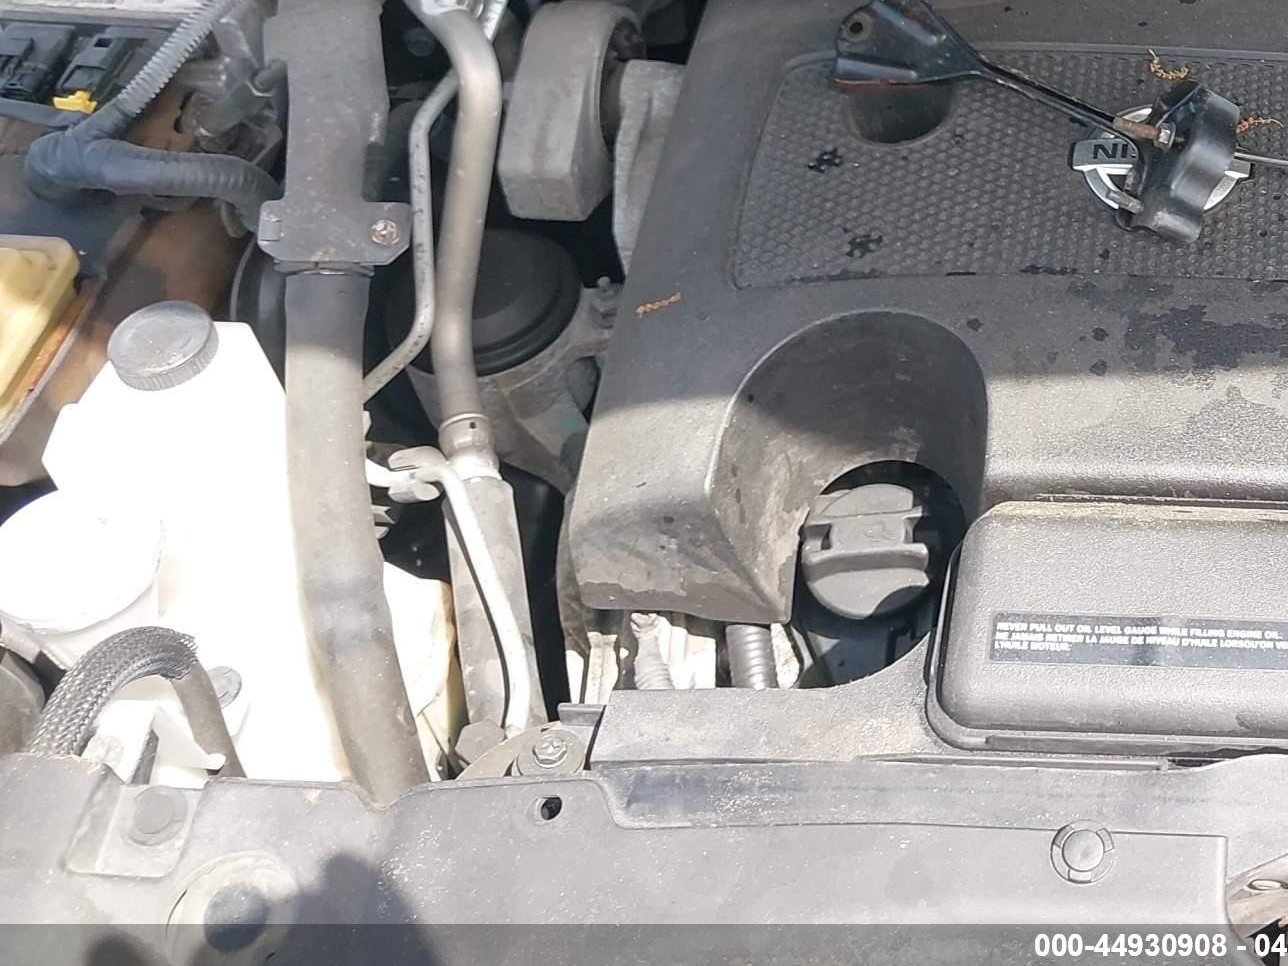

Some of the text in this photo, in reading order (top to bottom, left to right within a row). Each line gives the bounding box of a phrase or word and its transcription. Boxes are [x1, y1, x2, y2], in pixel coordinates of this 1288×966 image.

[997, 622, 1028, 631] NEVER
[1029, 623, 1052, 632] PULL
[1054, 624, 1075, 633] OUT
[1076, 624, 1092, 634] OIL
[1094, 625, 1122, 634] LEVEL
[1124, 626, 1157, 635] GAUGE
[1159, 626, 1188, 636] WHILE
[1190, 628, 1225, 638] FILLING
[1227, 629, 1262, 639] ENGINE
[995, 632, 1009, 640] NE
[1010, 632, 1044, 641] JAMAIS
[1045, 633, 1084, 643] RETIRER
[1085, 635, 1098, 644] LA
[1099, 635, 1129, 645] JAUGE
[1131, 636, 1144, 645] DE
[1146, 636, 1180, 646] NIVEAU
